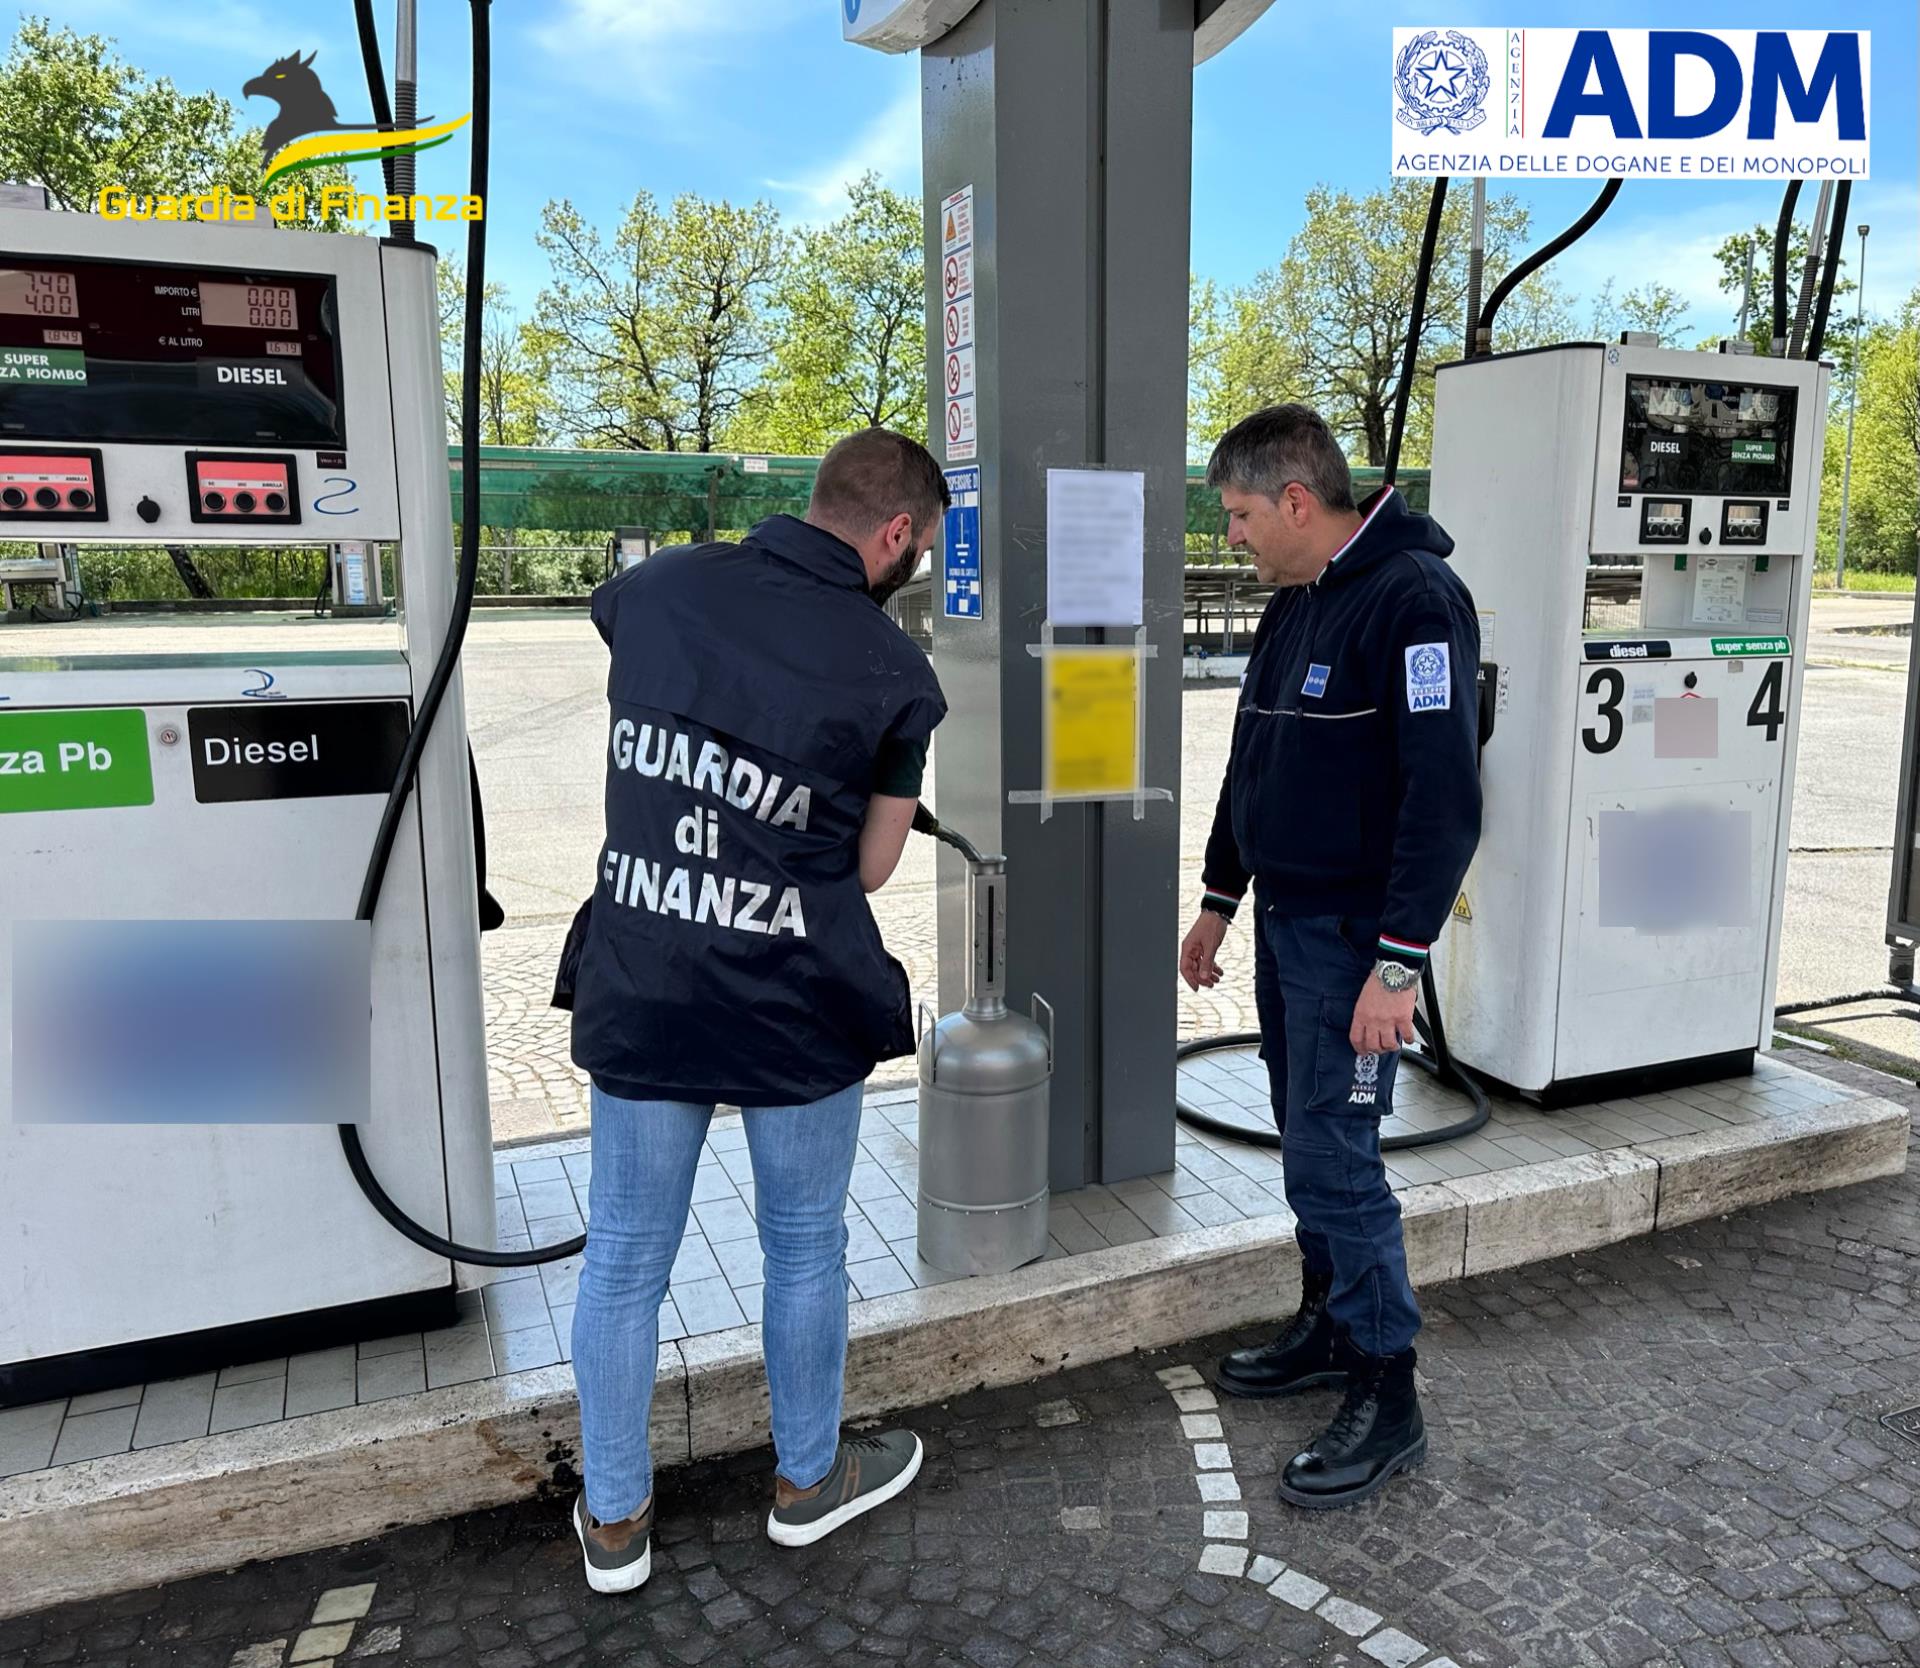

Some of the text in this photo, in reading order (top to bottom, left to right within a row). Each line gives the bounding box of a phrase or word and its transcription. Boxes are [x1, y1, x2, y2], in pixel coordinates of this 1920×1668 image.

[154, 285, 190, 297] IMPORTO
[247, 287, 290, 308] 0.00
[25, 294, 72, 315] 4.00
[181, 306, 200, 317] LITRI
[249, 307, 292, 328] 0.00
[168, 337, 179, 346] AL
[180, 337, 203, 347] LITRO
[4, 353, 50, 366] SUPER
[0, 366, 87, 381] ZA PIOMBO
[216, 366, 288, 386] DIESEL
[1650, 441, 1681, 454] DIESEL
[1745, 443, 1763, 452] SUPER
[1731, 451, 1776, 461] SENZA PIOMBO
[1609, 644, 1648, 658] diesel
[1715, 641, 1786, 654] super senza pb
[1413, 694, 1446, 709] ADM
[1746, 660, 1785, 742] 4
[1581, 667, 1625, 755] 3
[0, 741, 112, 775] za Pb
[204, 734, 319, 767] Diesel
[613, 718, 811, 832] GUARDIA
[674, 804, 719, 860] di
[603, 850, 807, 938] FINANZA
[1348, 1091, 1376, 1105] ADM
